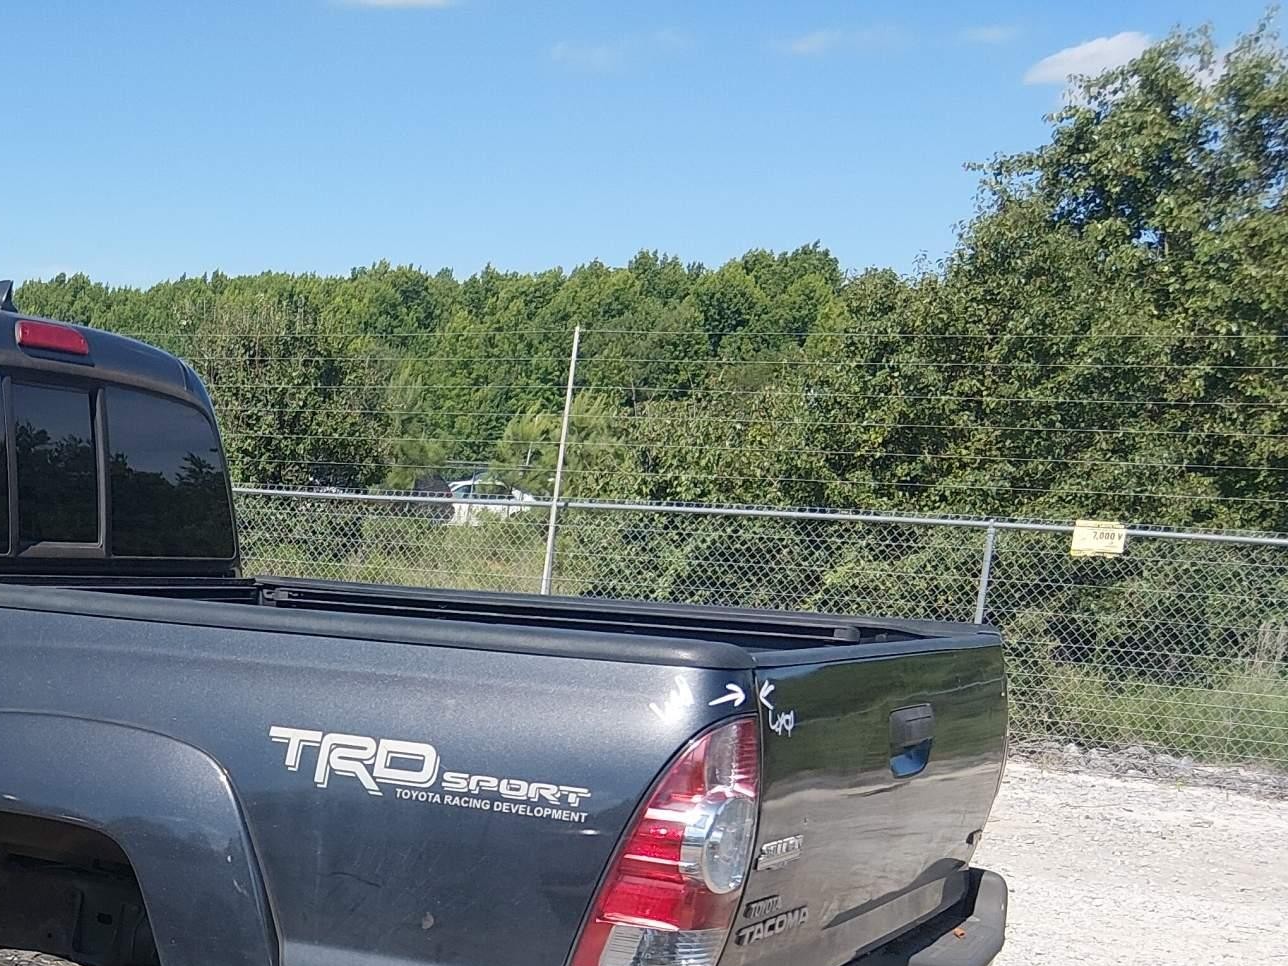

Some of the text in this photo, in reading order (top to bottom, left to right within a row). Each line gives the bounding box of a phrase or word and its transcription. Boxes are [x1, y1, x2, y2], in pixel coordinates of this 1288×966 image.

[269, 726, 591, 807] TRD SPORT
[395, 788, 589, 823] TOYOTA RACING DEVELOPMENT
[747, 895, 782, 918] TOYOTA
[736, 906, 810, 945] TACOMA
